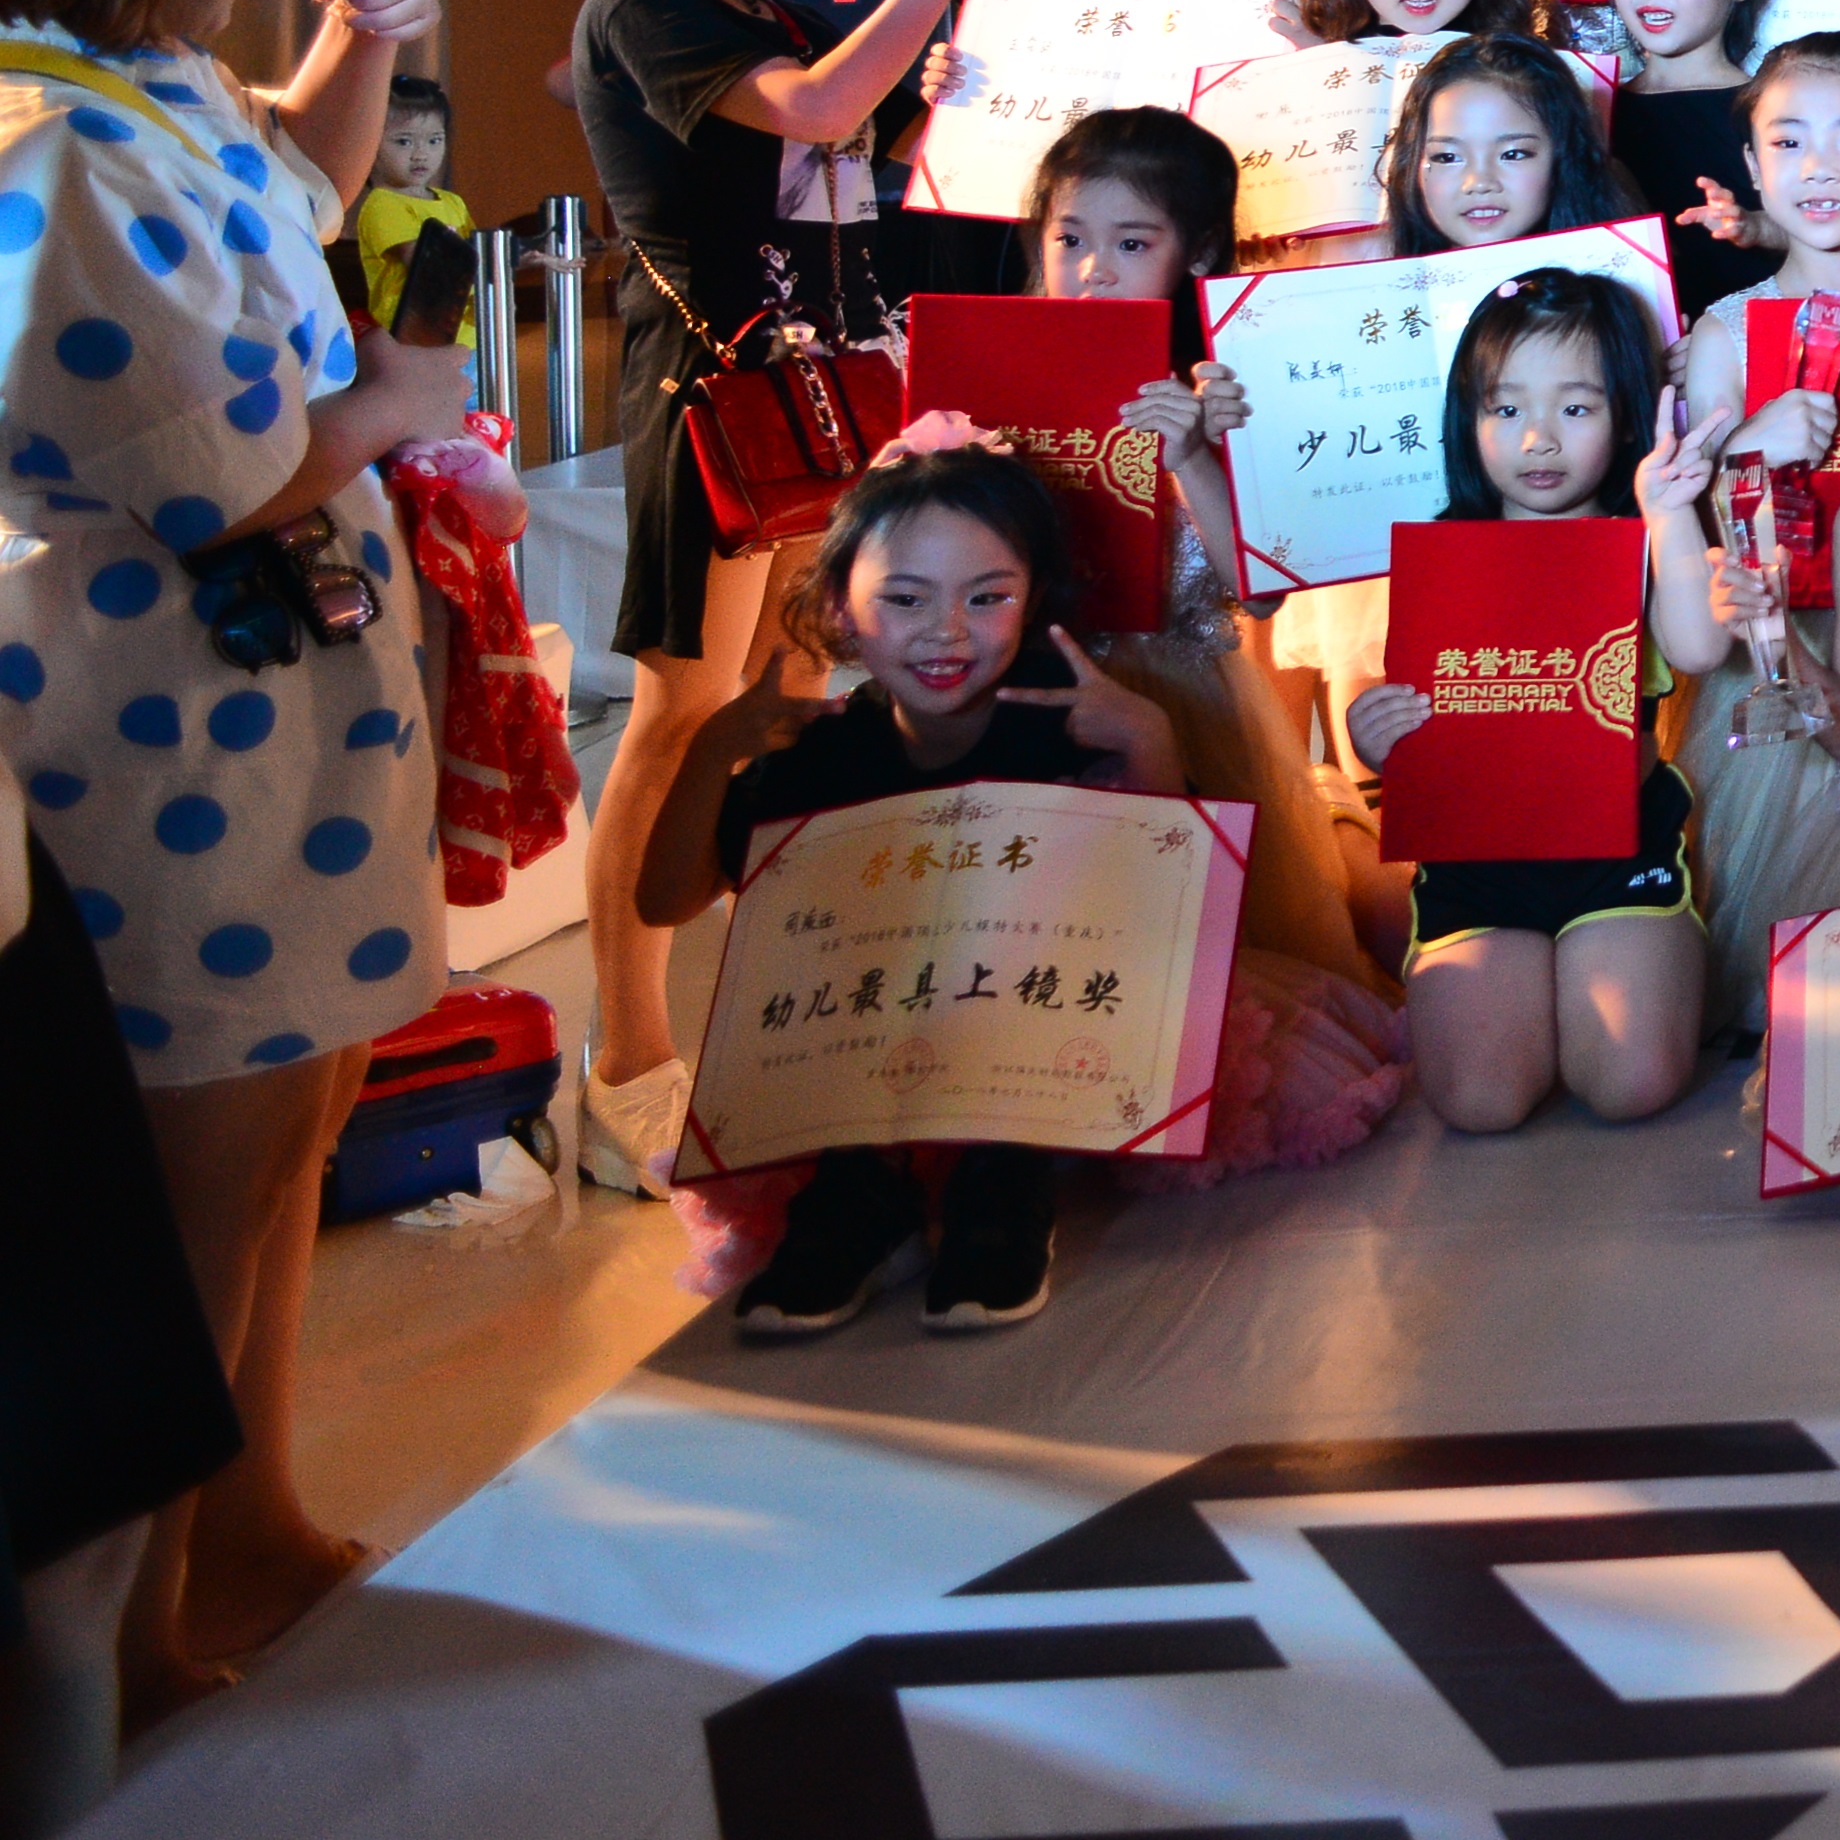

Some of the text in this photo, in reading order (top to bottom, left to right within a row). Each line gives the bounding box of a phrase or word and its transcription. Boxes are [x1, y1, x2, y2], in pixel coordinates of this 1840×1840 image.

[1433, 647, 1576, 677] 荣誉证书
[1434, 698, 1573, 713] CREDENTIAL
[1435, 684, 1574, 699] HONORARY
[861, 833, 1040, 889] 荣誉证书
[760, 961, 1122, 1032] 幼儿最具上镜奖
